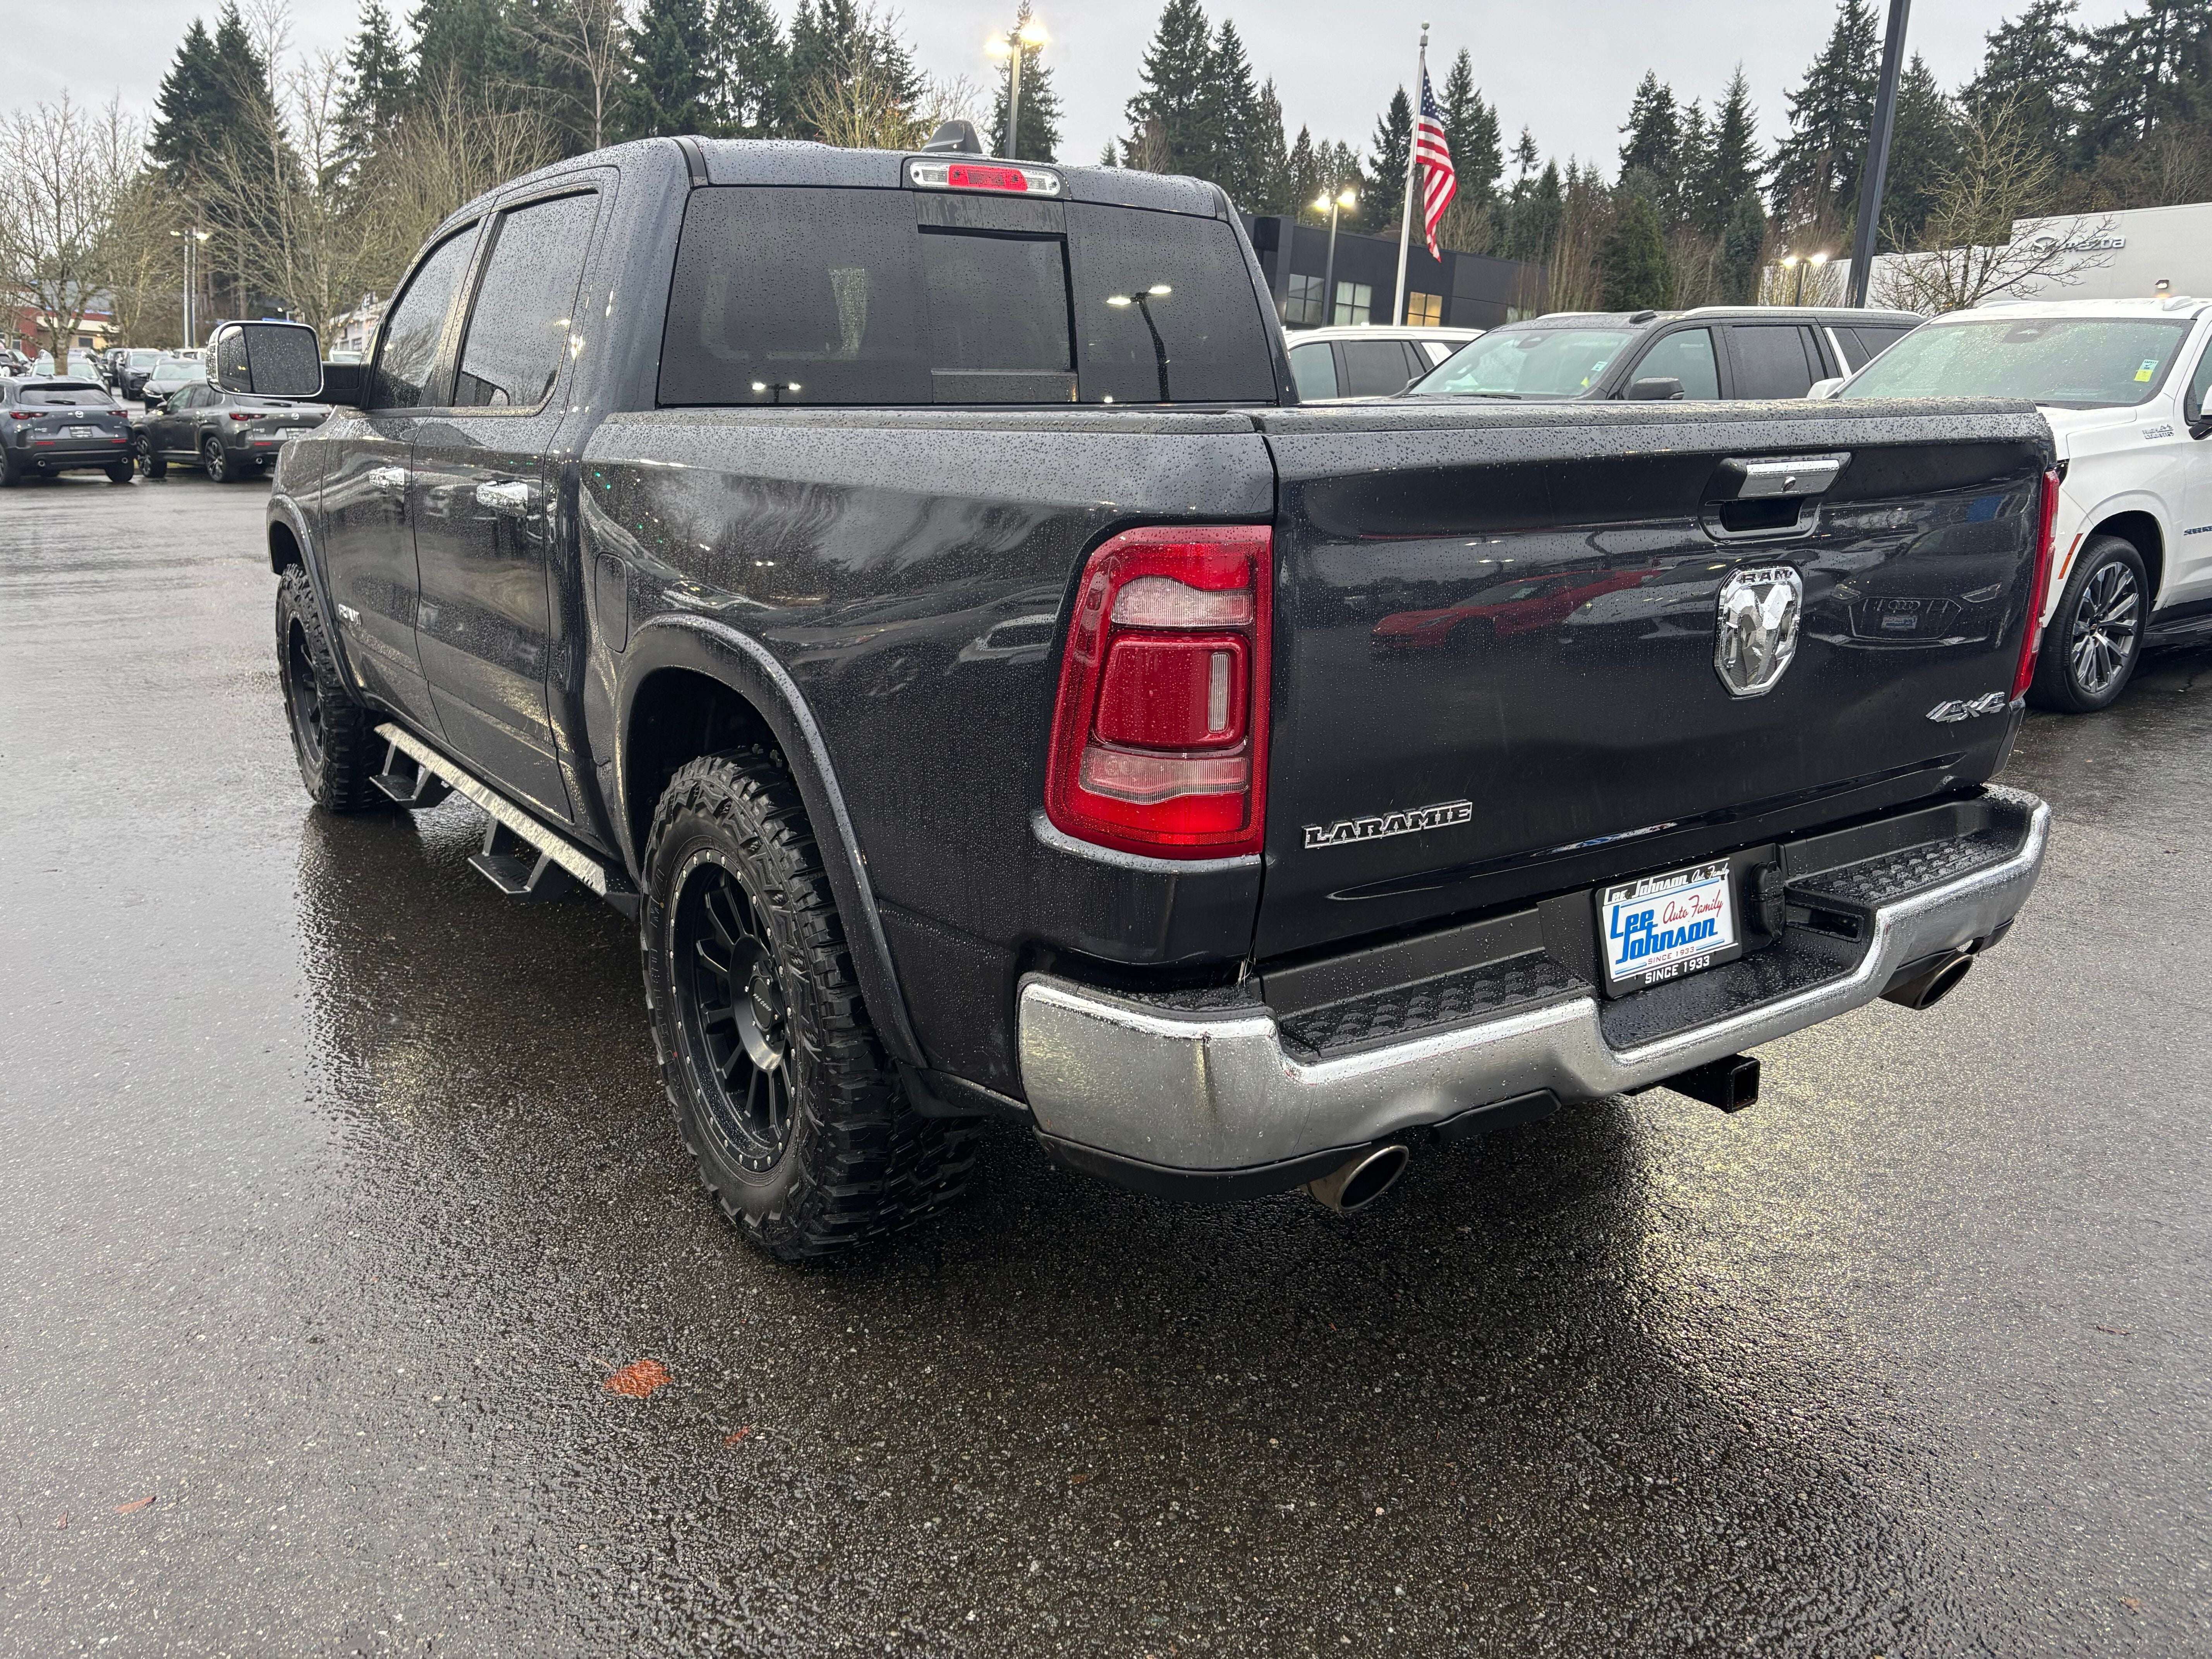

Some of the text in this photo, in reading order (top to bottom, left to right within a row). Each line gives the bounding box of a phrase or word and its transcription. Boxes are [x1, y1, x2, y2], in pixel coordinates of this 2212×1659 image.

[1739, 569, 1793, 584] RAM
[1302, 799, 1473, 848] LARAMIE
[1604, 887, 1628, 905] Lee
[1632, 875, 1689, 898] Johnson
[1610, 905, 1658, 939] Lee
[1663, 889, 1723, 924] Auto Family
[1615, 917, 1718, 965] Johnson
[1647, 946, 1694, 965] SINCE 1933
[1645, 955, 1710, 984] SINCE 1933
